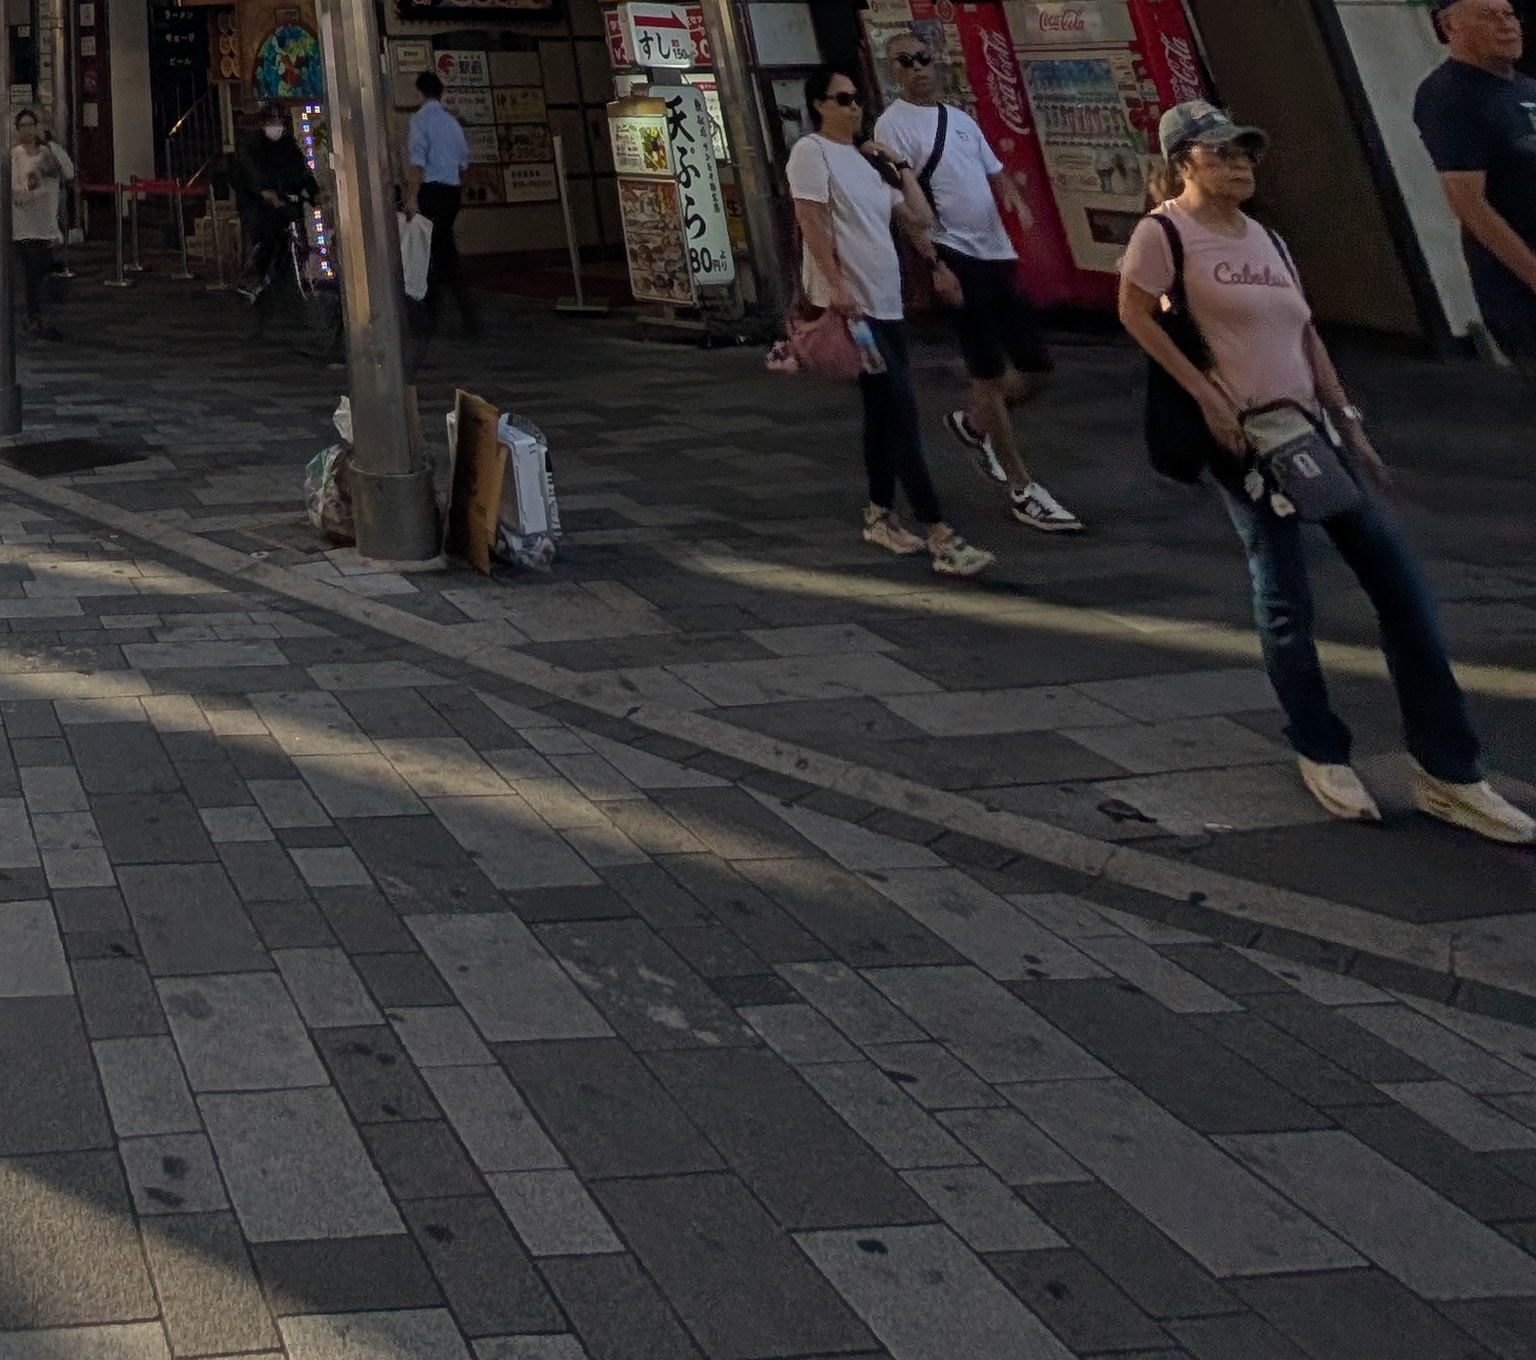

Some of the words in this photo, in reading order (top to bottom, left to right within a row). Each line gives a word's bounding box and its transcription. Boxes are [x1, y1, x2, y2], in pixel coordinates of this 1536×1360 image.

[639, 30, 670, 60] すし
[665, 95, 707, 240] 天ぷら
